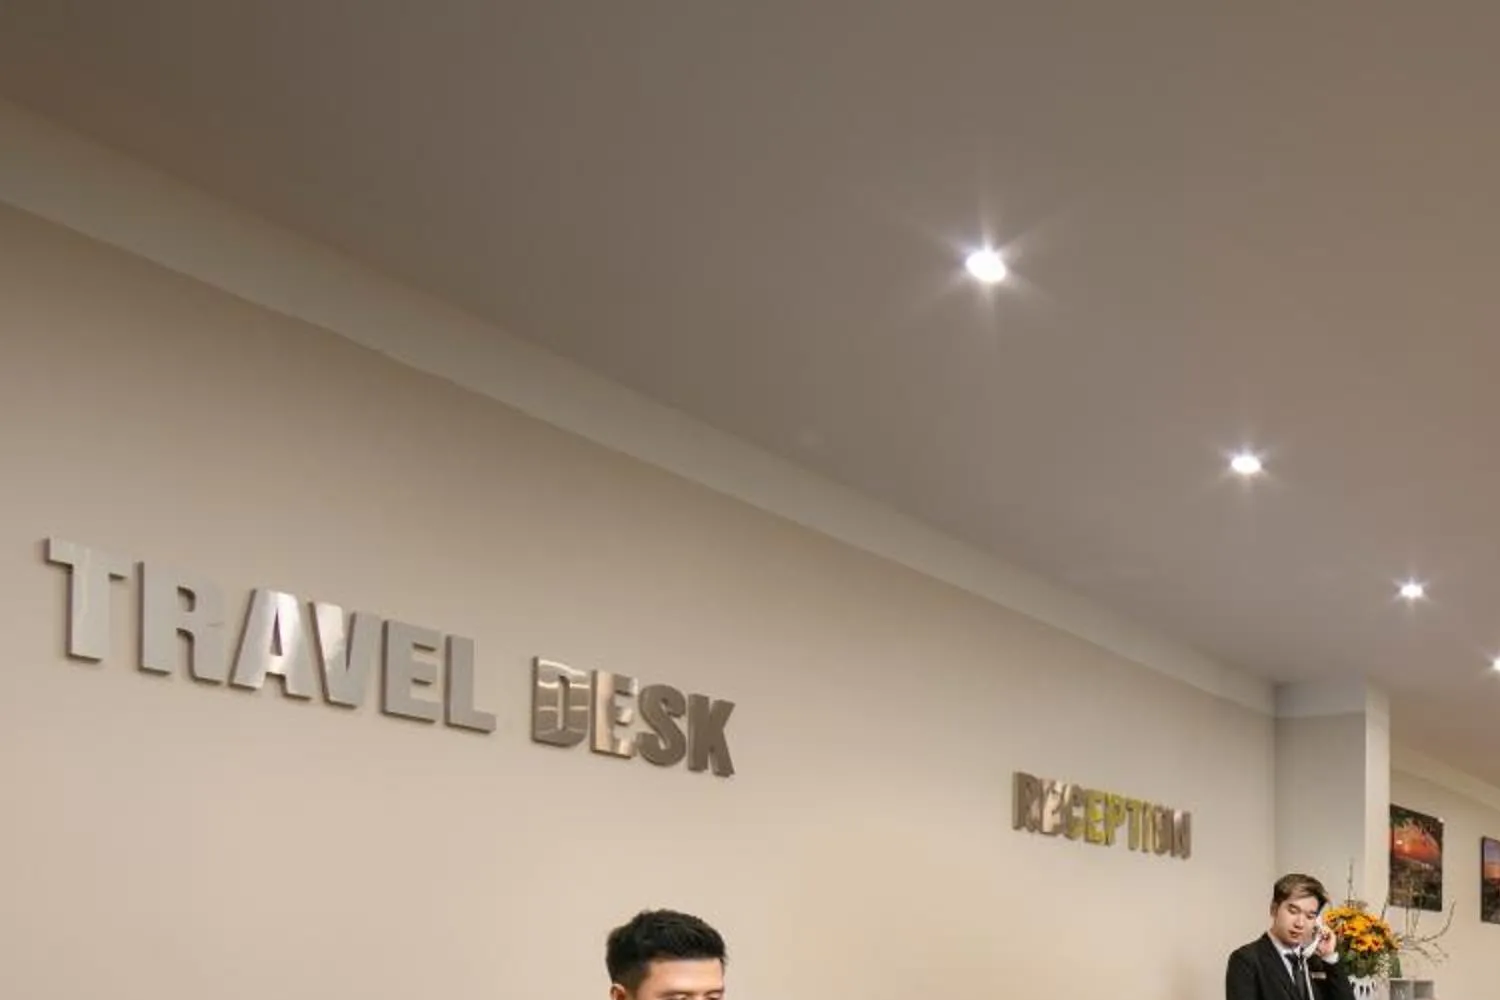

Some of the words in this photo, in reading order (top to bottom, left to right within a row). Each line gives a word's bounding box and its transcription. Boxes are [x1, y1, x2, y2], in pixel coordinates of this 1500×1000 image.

[43, 537, 497, 734] TRAVEL
[531, 655, 735, 777] DESK
[1012, 771, 1191, 860] RECEPTION
